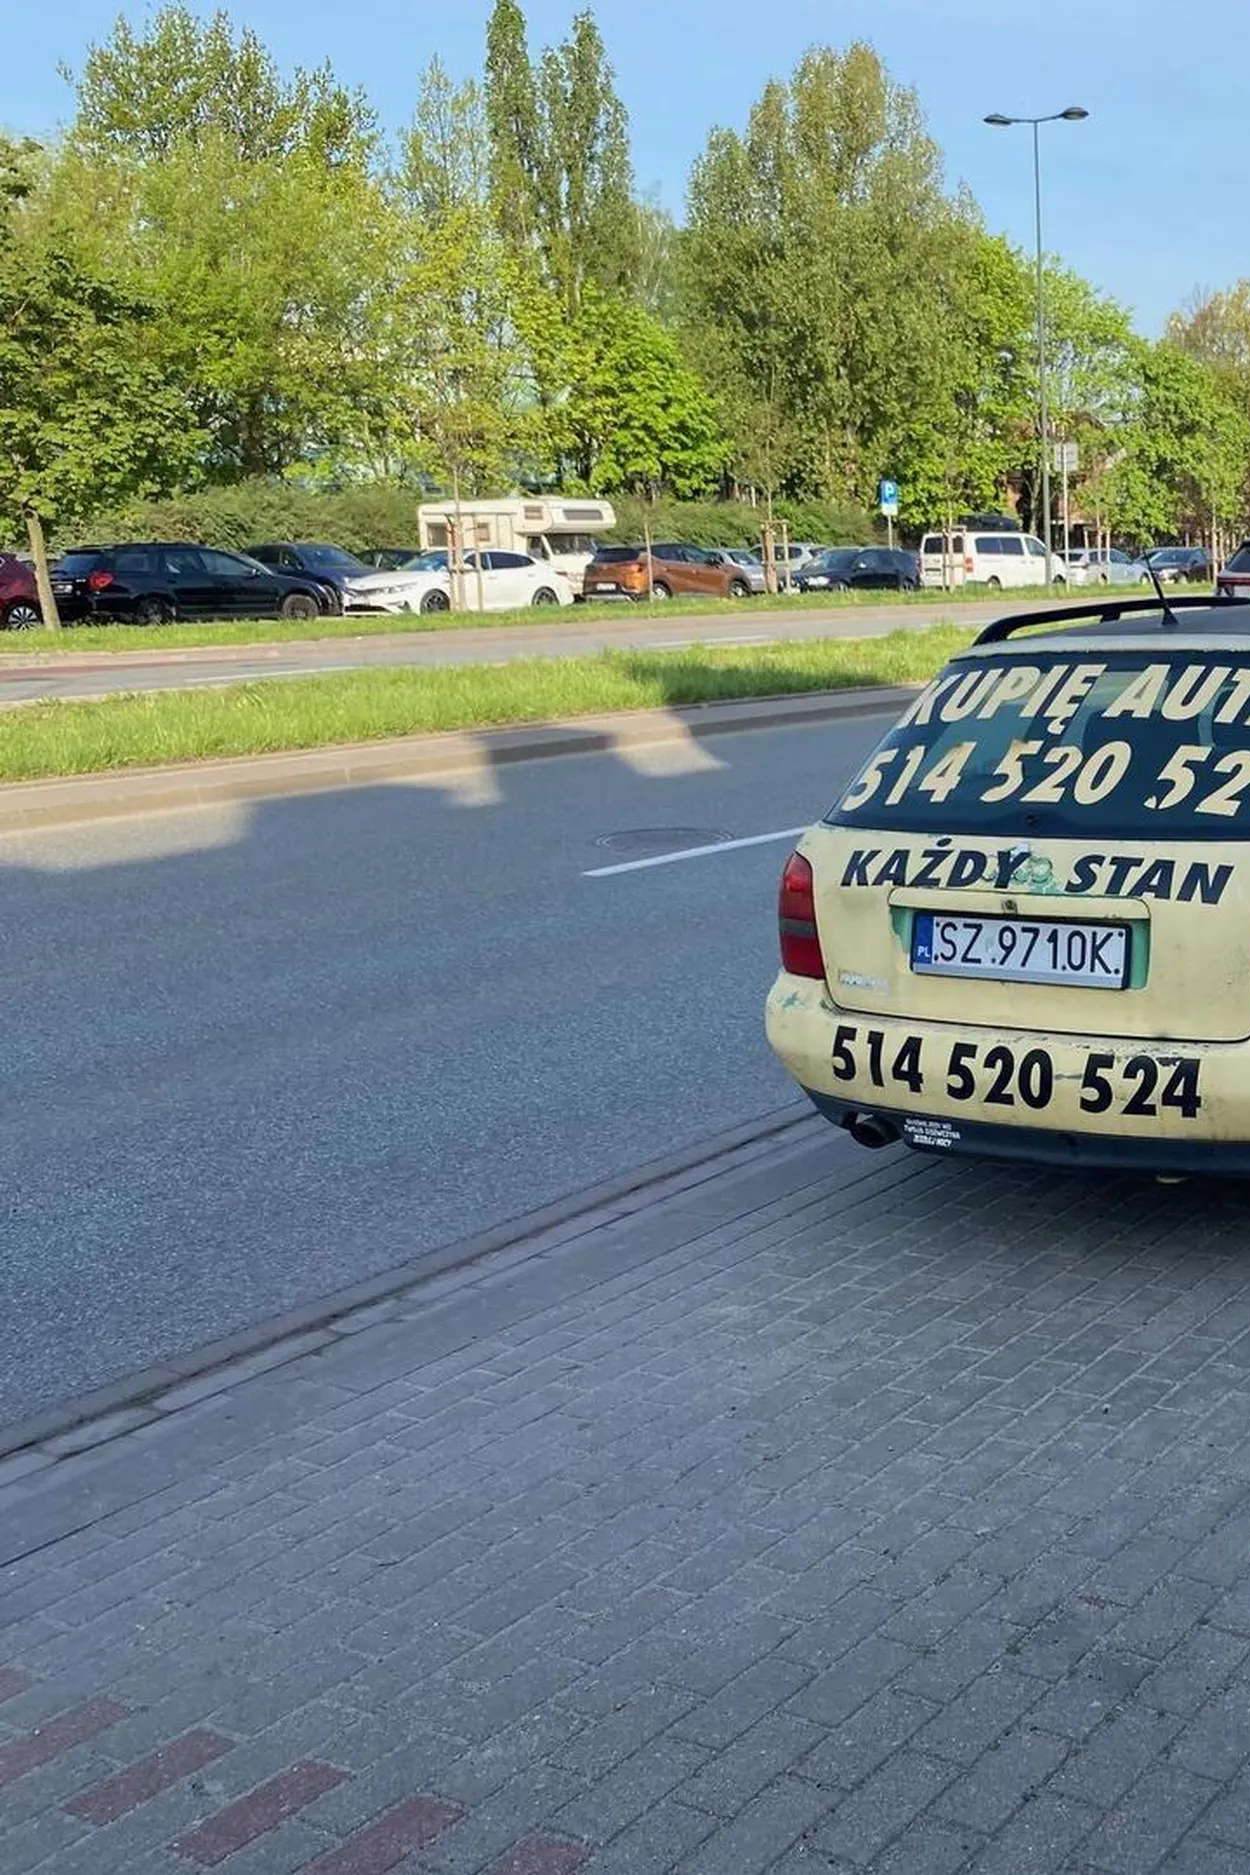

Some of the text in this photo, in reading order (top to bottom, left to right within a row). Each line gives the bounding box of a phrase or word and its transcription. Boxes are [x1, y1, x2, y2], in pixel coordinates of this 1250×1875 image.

[897, 664, 1107, 735] KUPIĘ
[841, 741, 978, 811] 514
[980, 739, 1133, 805] 520
[840, 837, 1235, 906] KAŻDY STAN
[917, 946, 931, 958] PL
[940, 921, 1113, 975] SZ 9710K
[832, 1025, 1202, 1119] 514 520 524
